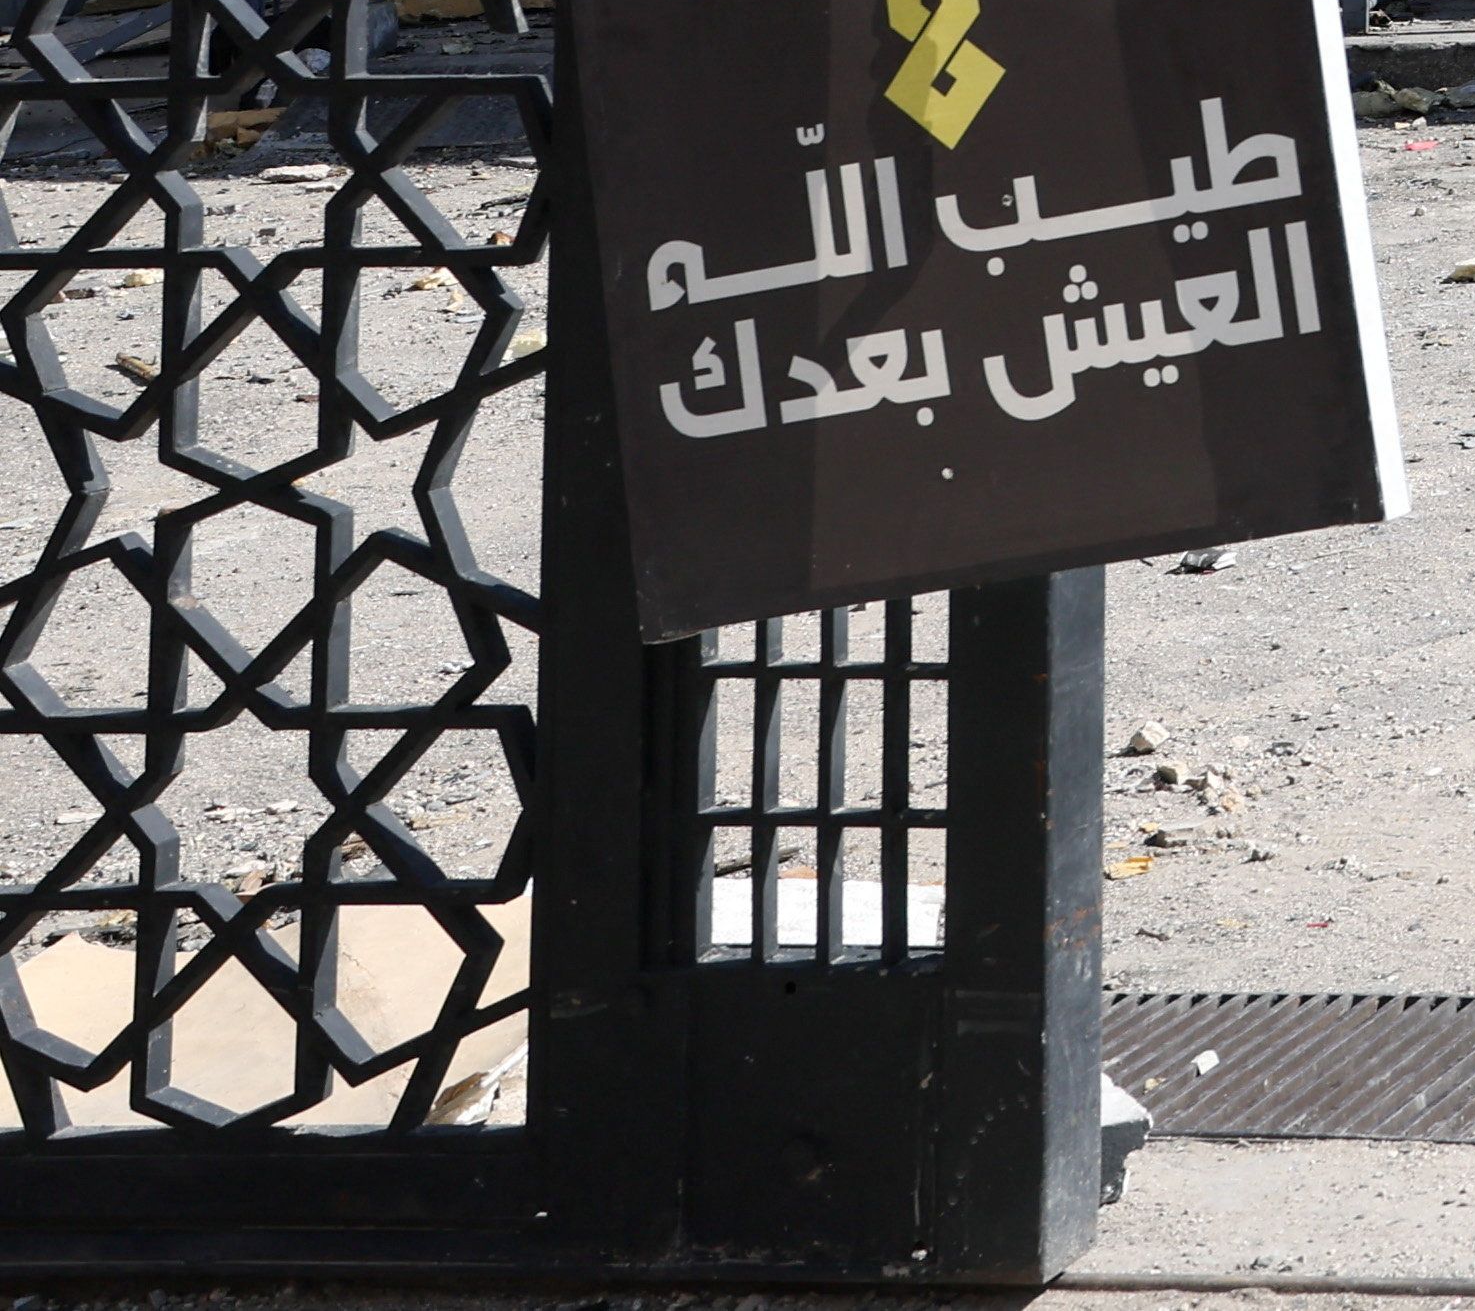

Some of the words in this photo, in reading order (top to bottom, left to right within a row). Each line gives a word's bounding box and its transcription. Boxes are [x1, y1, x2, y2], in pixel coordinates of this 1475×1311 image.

[934, 96, 1303, 277] طيب
[659, 318, 952, 439] بعدك
[982, 220, 1322, 421] العيش
